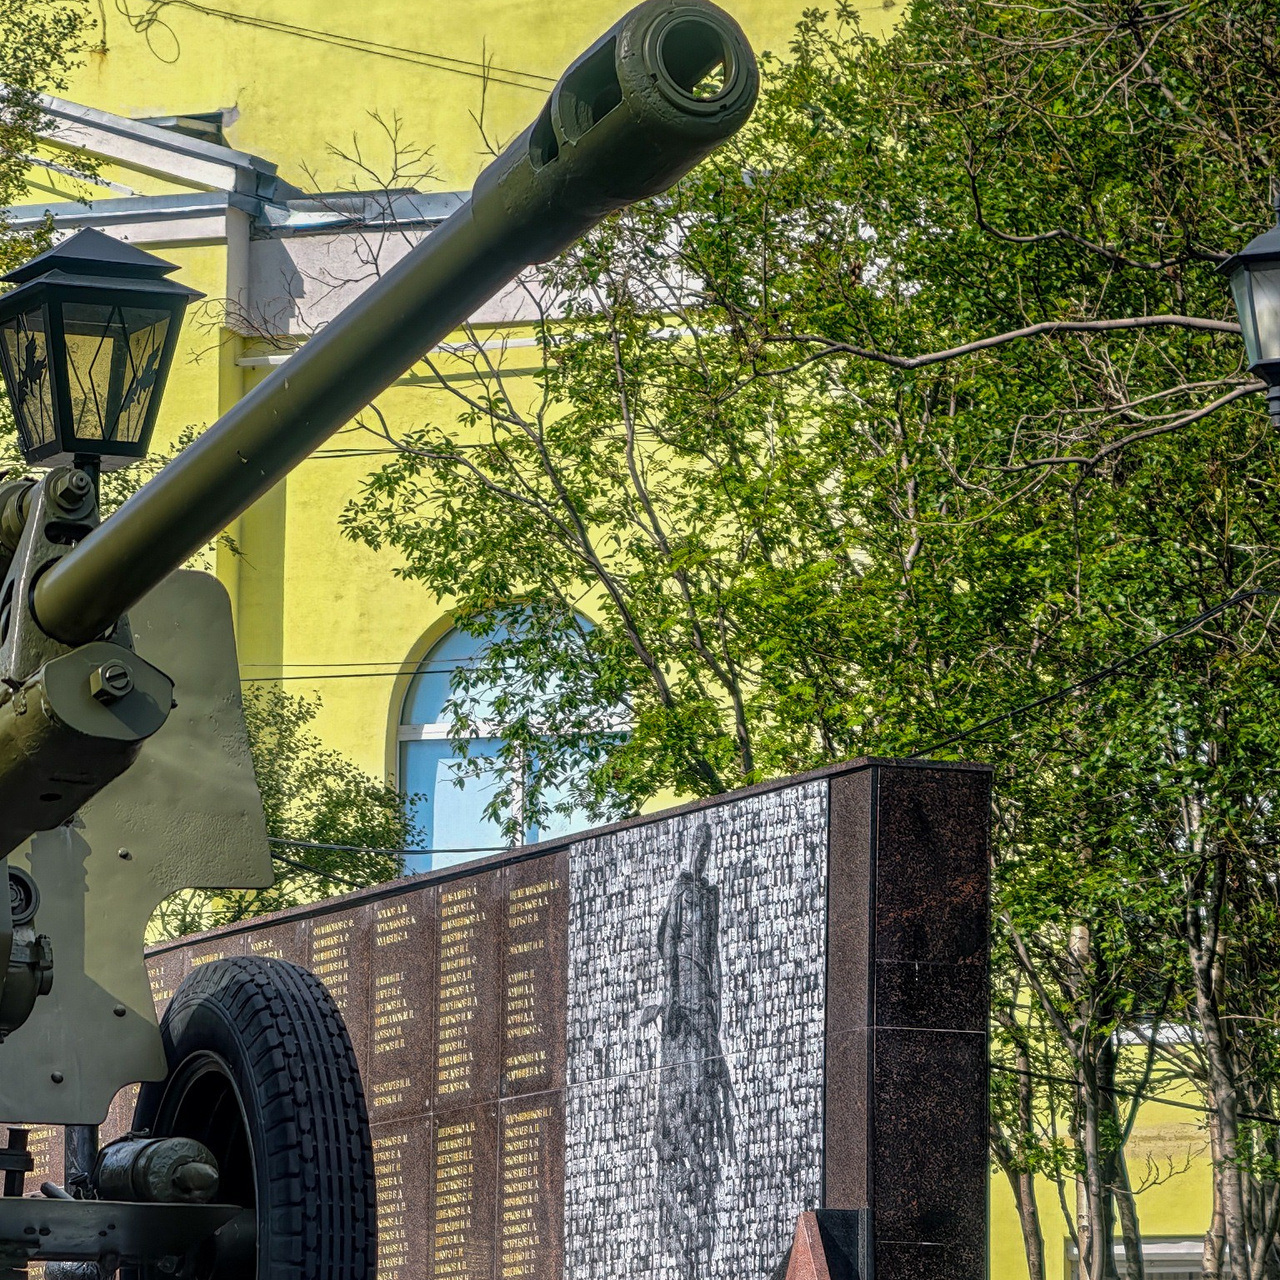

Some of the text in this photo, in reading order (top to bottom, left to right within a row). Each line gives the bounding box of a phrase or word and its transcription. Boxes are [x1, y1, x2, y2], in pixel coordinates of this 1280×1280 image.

[505, 1125, 528, 1138] ЯКОВЛЕВ
[505, 1139, 528, 1152] ЯКОВЛЕВ
[504, 1153, 528, 1166] ЯКОВЛЕВ
[504, 1167, 527, 1180] ЯКОВЛЕВ
[504, 1181, 528, 1193] ЯКОВЛЕВ
